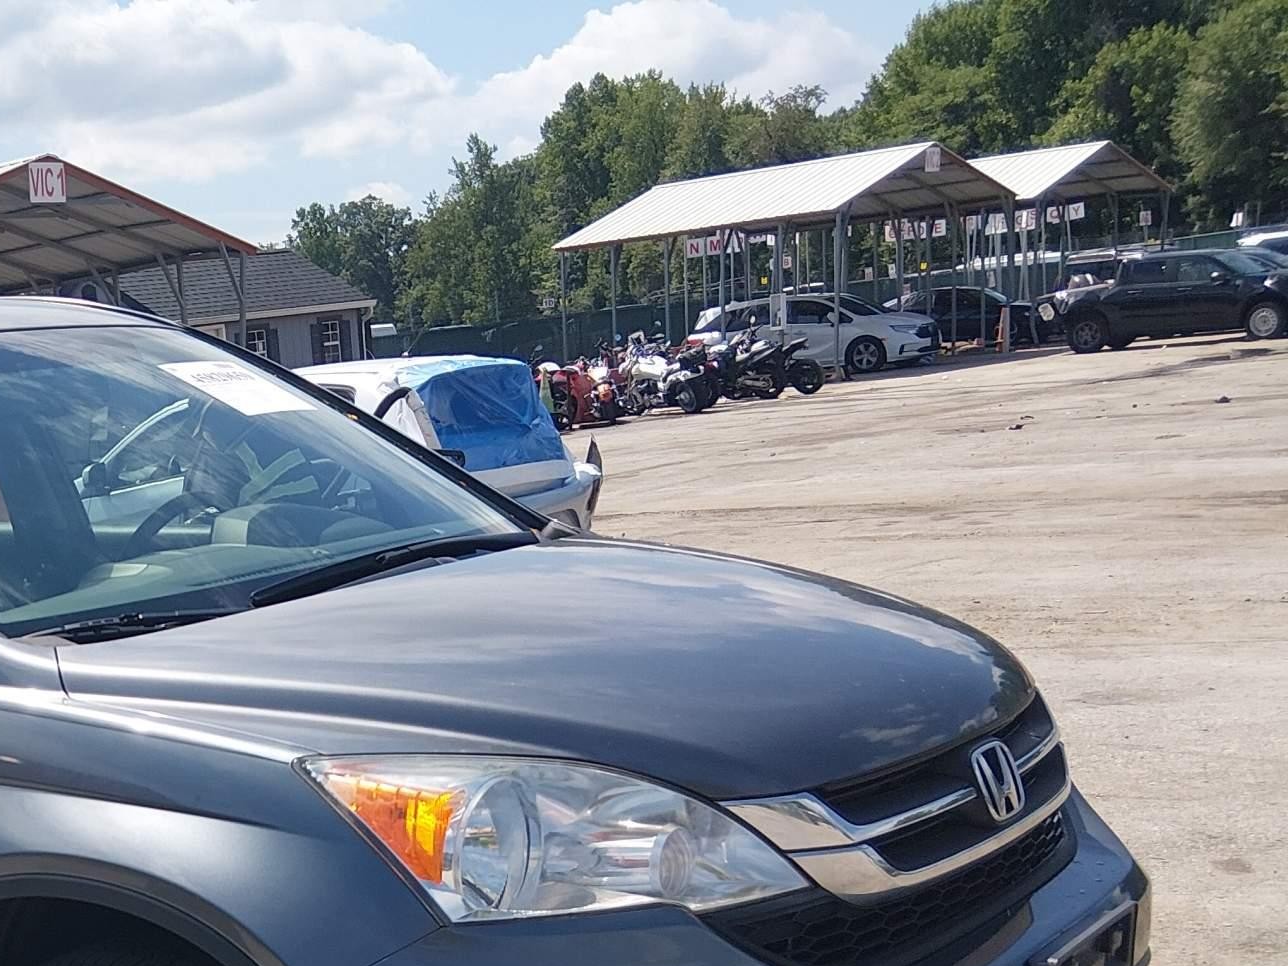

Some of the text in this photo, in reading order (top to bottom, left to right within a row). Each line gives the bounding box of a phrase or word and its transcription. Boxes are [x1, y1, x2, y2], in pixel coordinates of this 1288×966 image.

[29, 167, 65, 198] VIC 1
[689, 242, 700, 255] N
[709, 239, 721, 252] M
